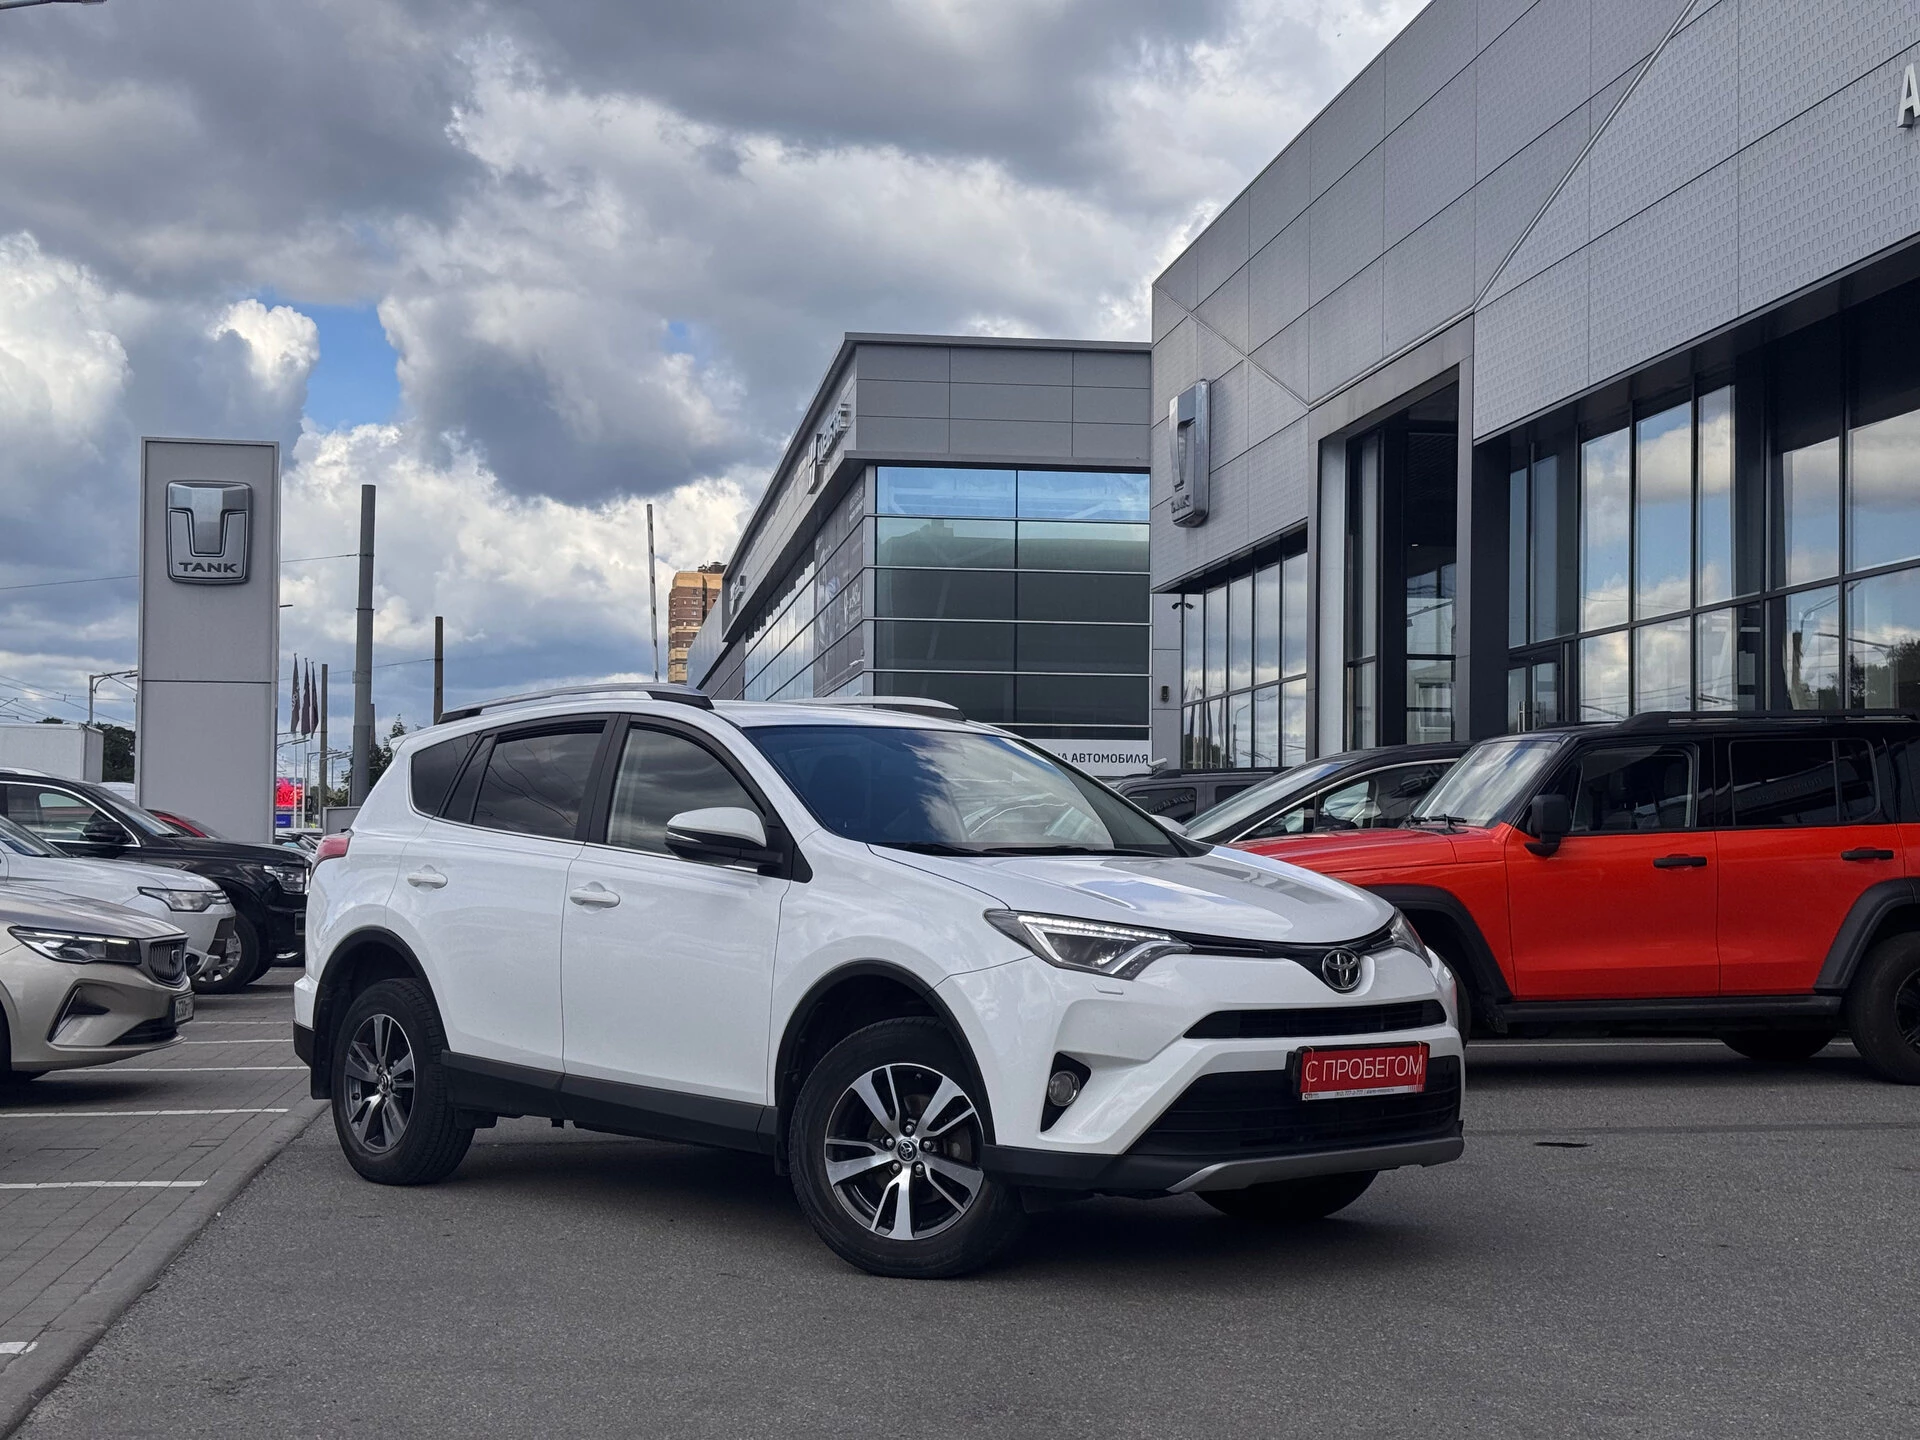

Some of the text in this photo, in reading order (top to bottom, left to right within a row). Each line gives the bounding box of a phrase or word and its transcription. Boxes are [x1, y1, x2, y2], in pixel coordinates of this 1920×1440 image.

[178, 562, 237, 573] TANK
[1071, 753, 1149, 763] АВТОМОБИЛЯ
[1305, 1054, 1423, 1082] С ПРОБЕГОМ
